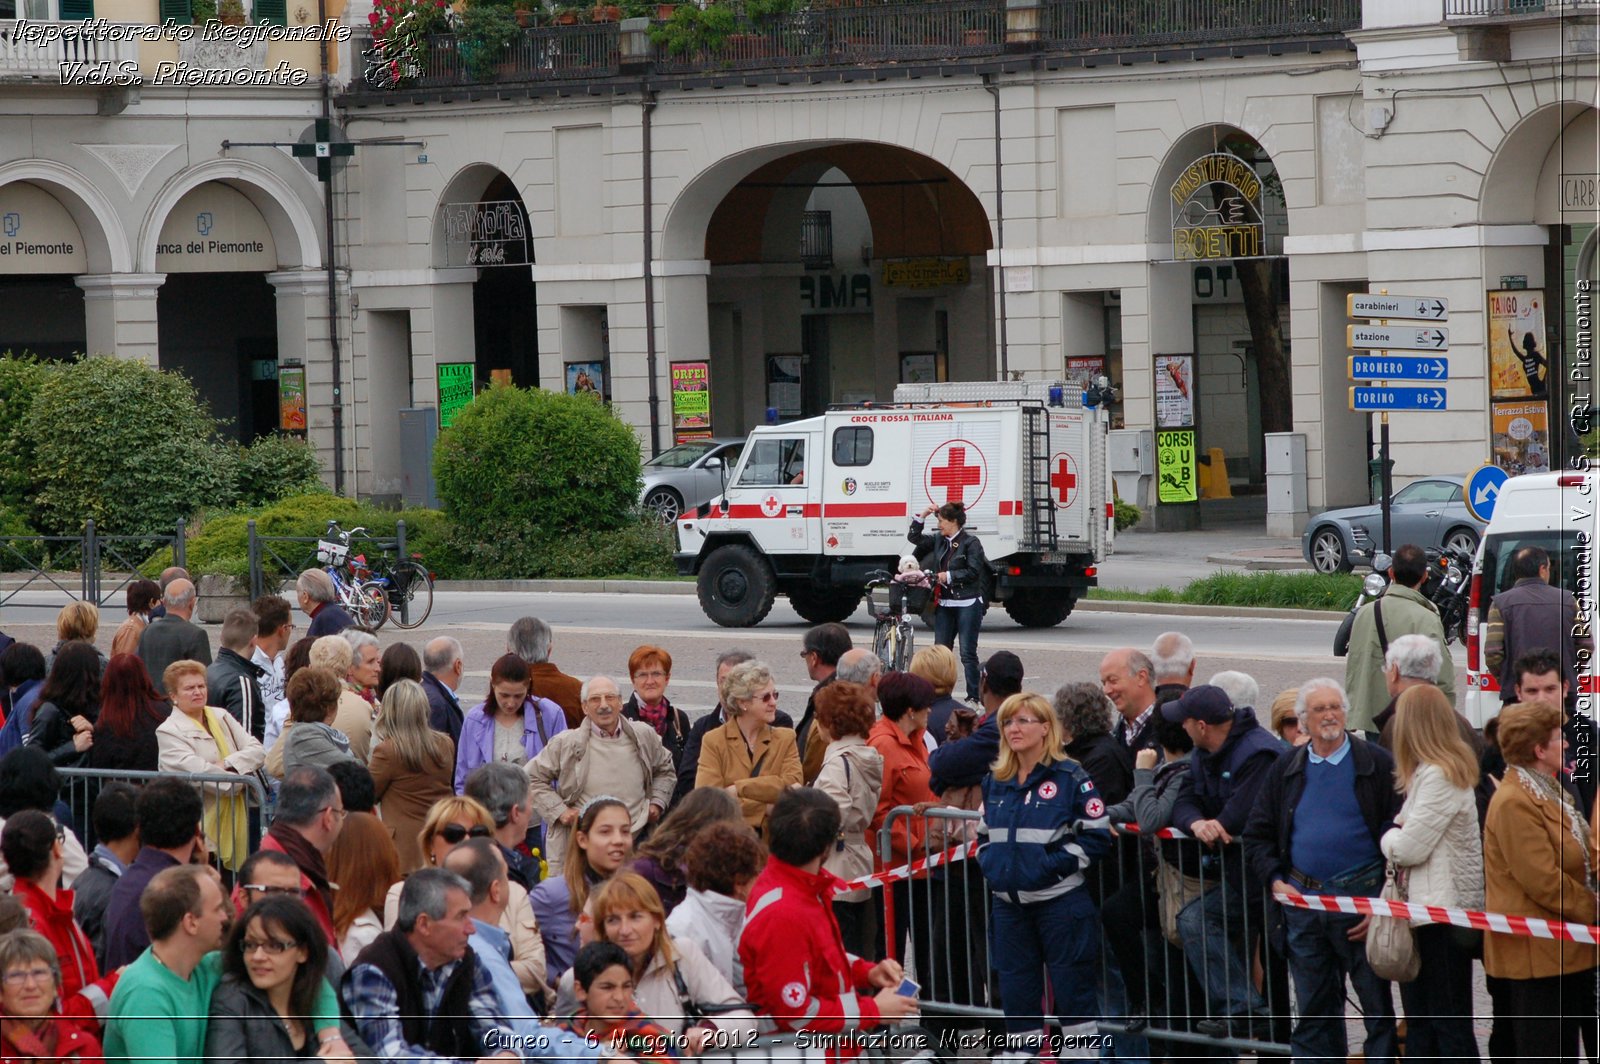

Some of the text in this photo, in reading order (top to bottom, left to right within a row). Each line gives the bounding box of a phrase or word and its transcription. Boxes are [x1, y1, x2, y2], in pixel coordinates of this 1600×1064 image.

[1171, 157, 1261, 206] PASTIFICIO
[156, 240, 264, 255] anca del Piemonte
[1174, 225, 1259, 259] BOETTI
[0, 242, 73, 255] el Piemonte
[1355, 302, 1399, 311] carabinieri
[1491, 296, 1517, 314] TANGO
[1355, 332, 1390, 341] stazione
[439, 366, 471, 377] ITALO
[673, 368, 706, 379] ORFEI
[1355, 362, 1429, 374] DRONERO 20
[1357, 392, 1429, 404] TORINO 86
[1494, 405, 1545, 416] Terrazza Estiva
[913, 413, 954, 421] ITALIANA
[1158, 432, 1192, 447] CORSI
